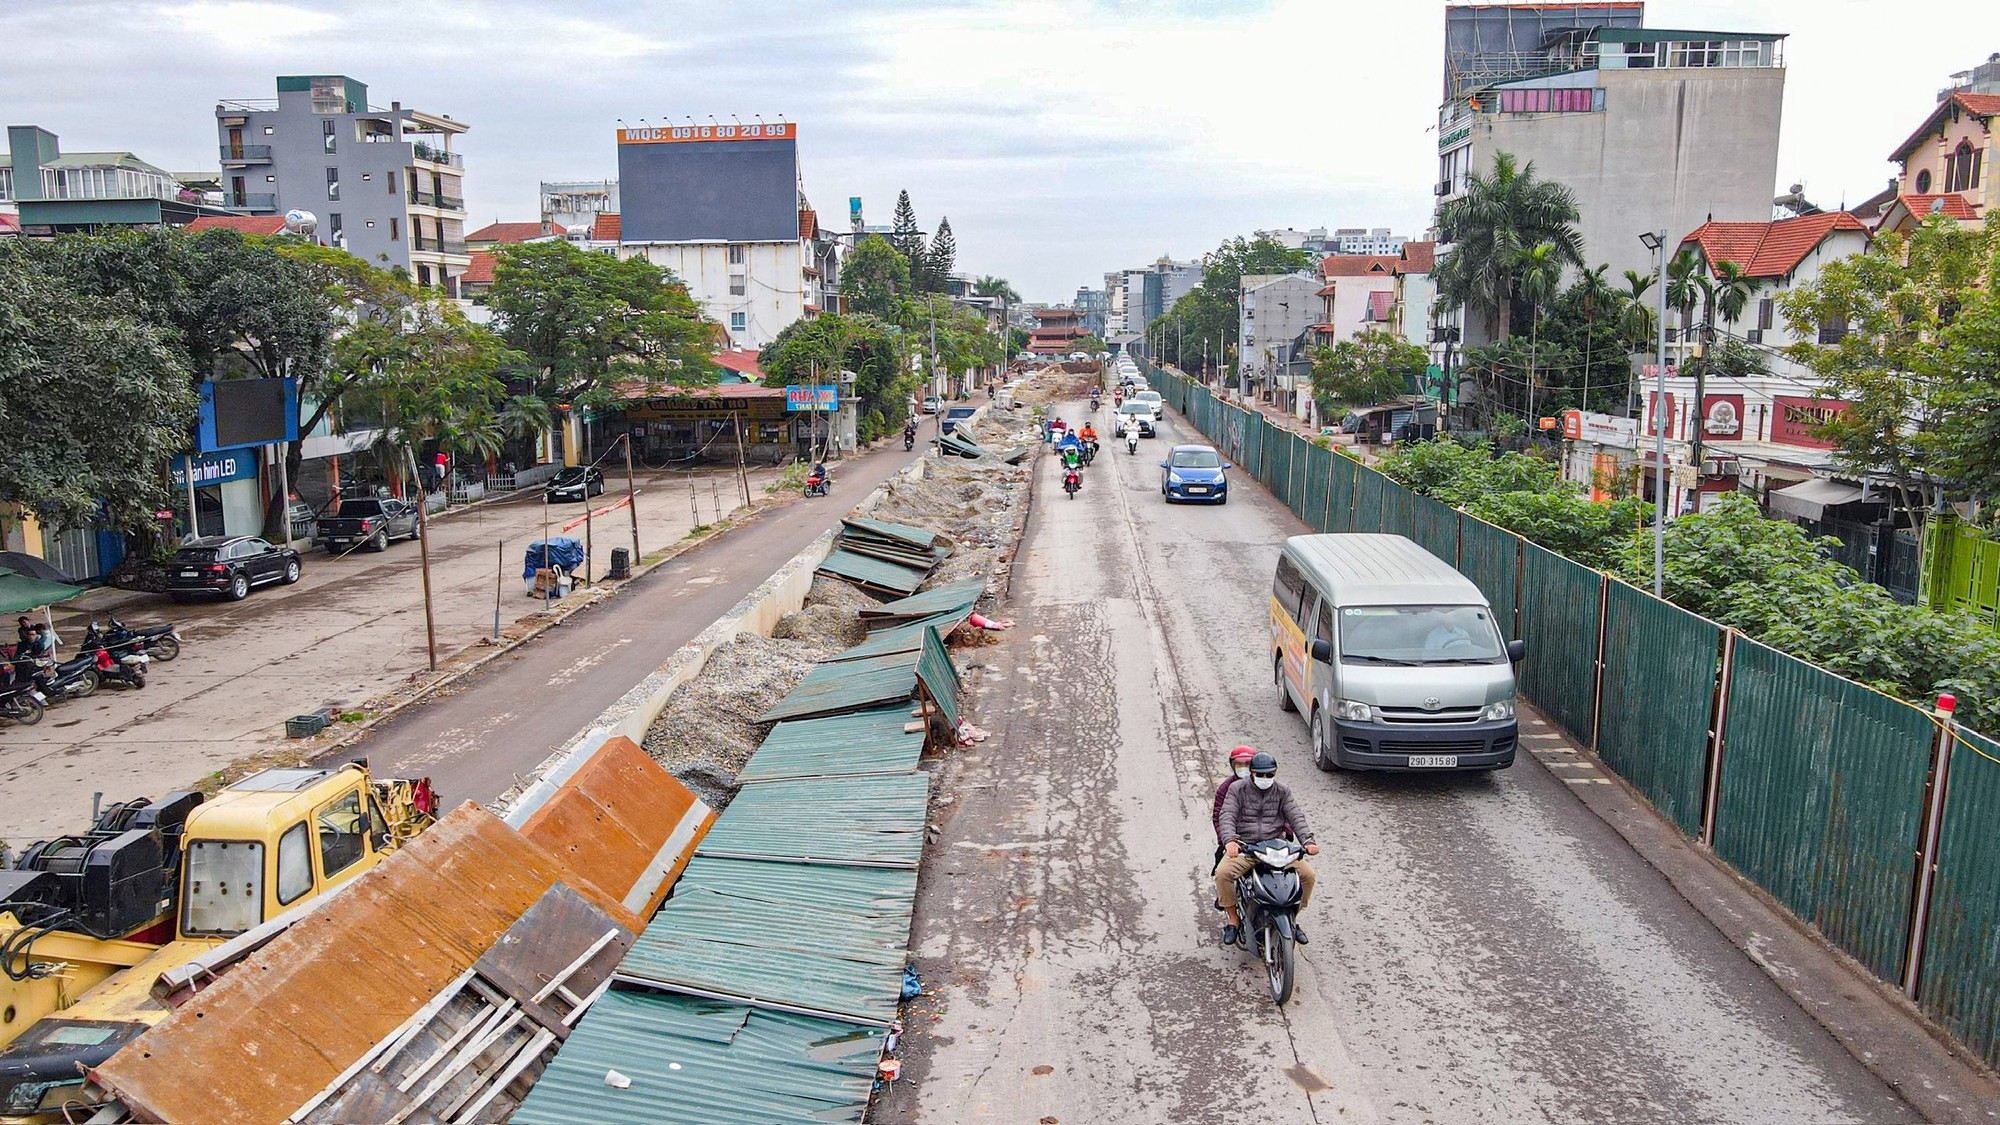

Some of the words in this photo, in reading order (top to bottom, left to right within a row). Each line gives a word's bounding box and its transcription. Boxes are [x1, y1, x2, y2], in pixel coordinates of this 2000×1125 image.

[626, 128, 666, 140] MQC:
[672, 126, 710, 139] 0916
[716, 125, 736, 137] 80
[741, 125, 761, 137] 20
[766, 124, 786, 136] 99
[203, 461, 219, 480] hình
[220, 459, 236, 477] LED
